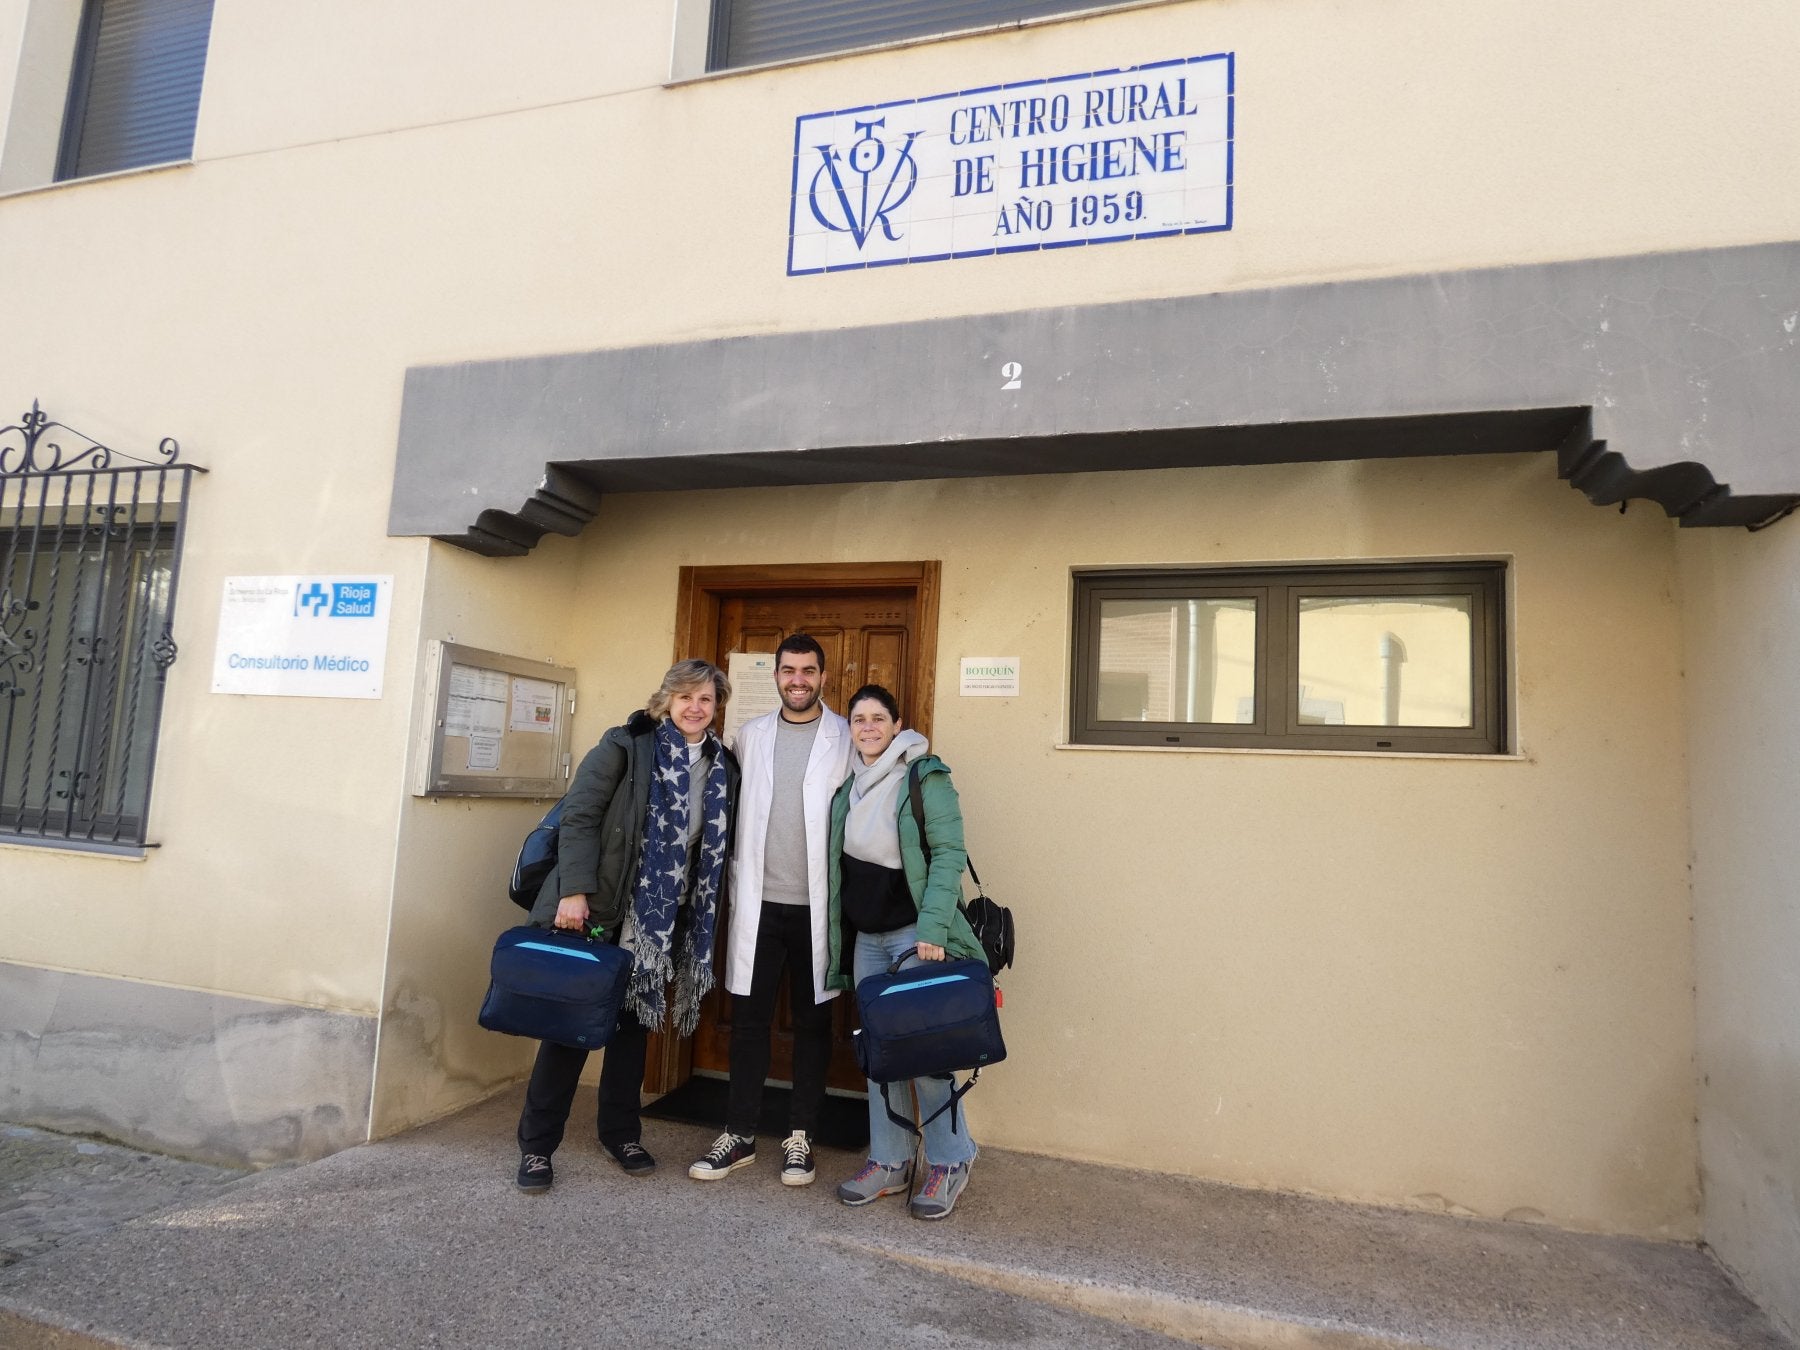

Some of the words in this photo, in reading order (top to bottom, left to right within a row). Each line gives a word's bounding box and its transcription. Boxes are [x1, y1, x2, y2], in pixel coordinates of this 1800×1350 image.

[949, 94, 1069, 146] CENTRO
[1082, 78, 1198, 129] RURAL
[950, 155, 995, 198] DE
[1019, 130, 1187, 189] HIGIENE
[992, 196, 1053, 237] AÑO
[1001, 362, 1022, 390] 2
[340, 586, 370, 601] Rioja
[336, 601, 371, 615] Salud
[228, 653, 309, 671] Consultorio
[313, 655, 370, 672] Médico
[965, 665, 1015, 677] BOTIQUÍN
